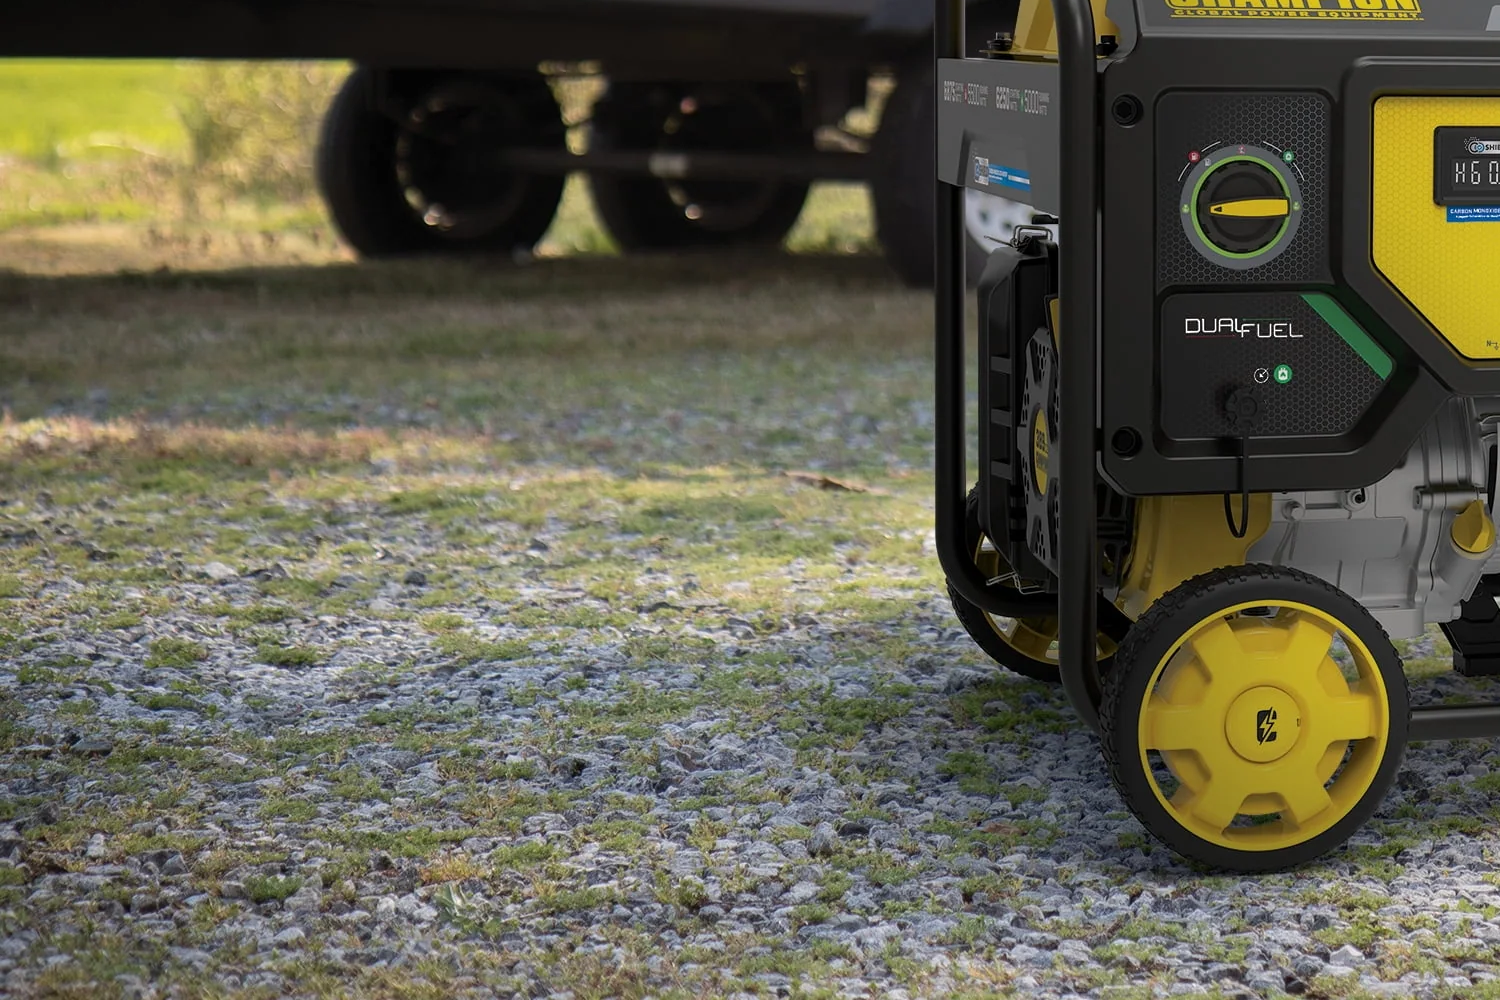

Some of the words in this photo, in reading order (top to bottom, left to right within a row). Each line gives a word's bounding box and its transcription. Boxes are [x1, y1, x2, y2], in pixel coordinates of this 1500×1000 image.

[1173, 9, 1242, 17] GLOBAL
[1249, 10, 1308, 18] POWER
[1318, 11, 1419, 19] EQUIPMENT
[995, 86, 1010, 110] 6250
[1024, 89, 1039, 114] 5000
